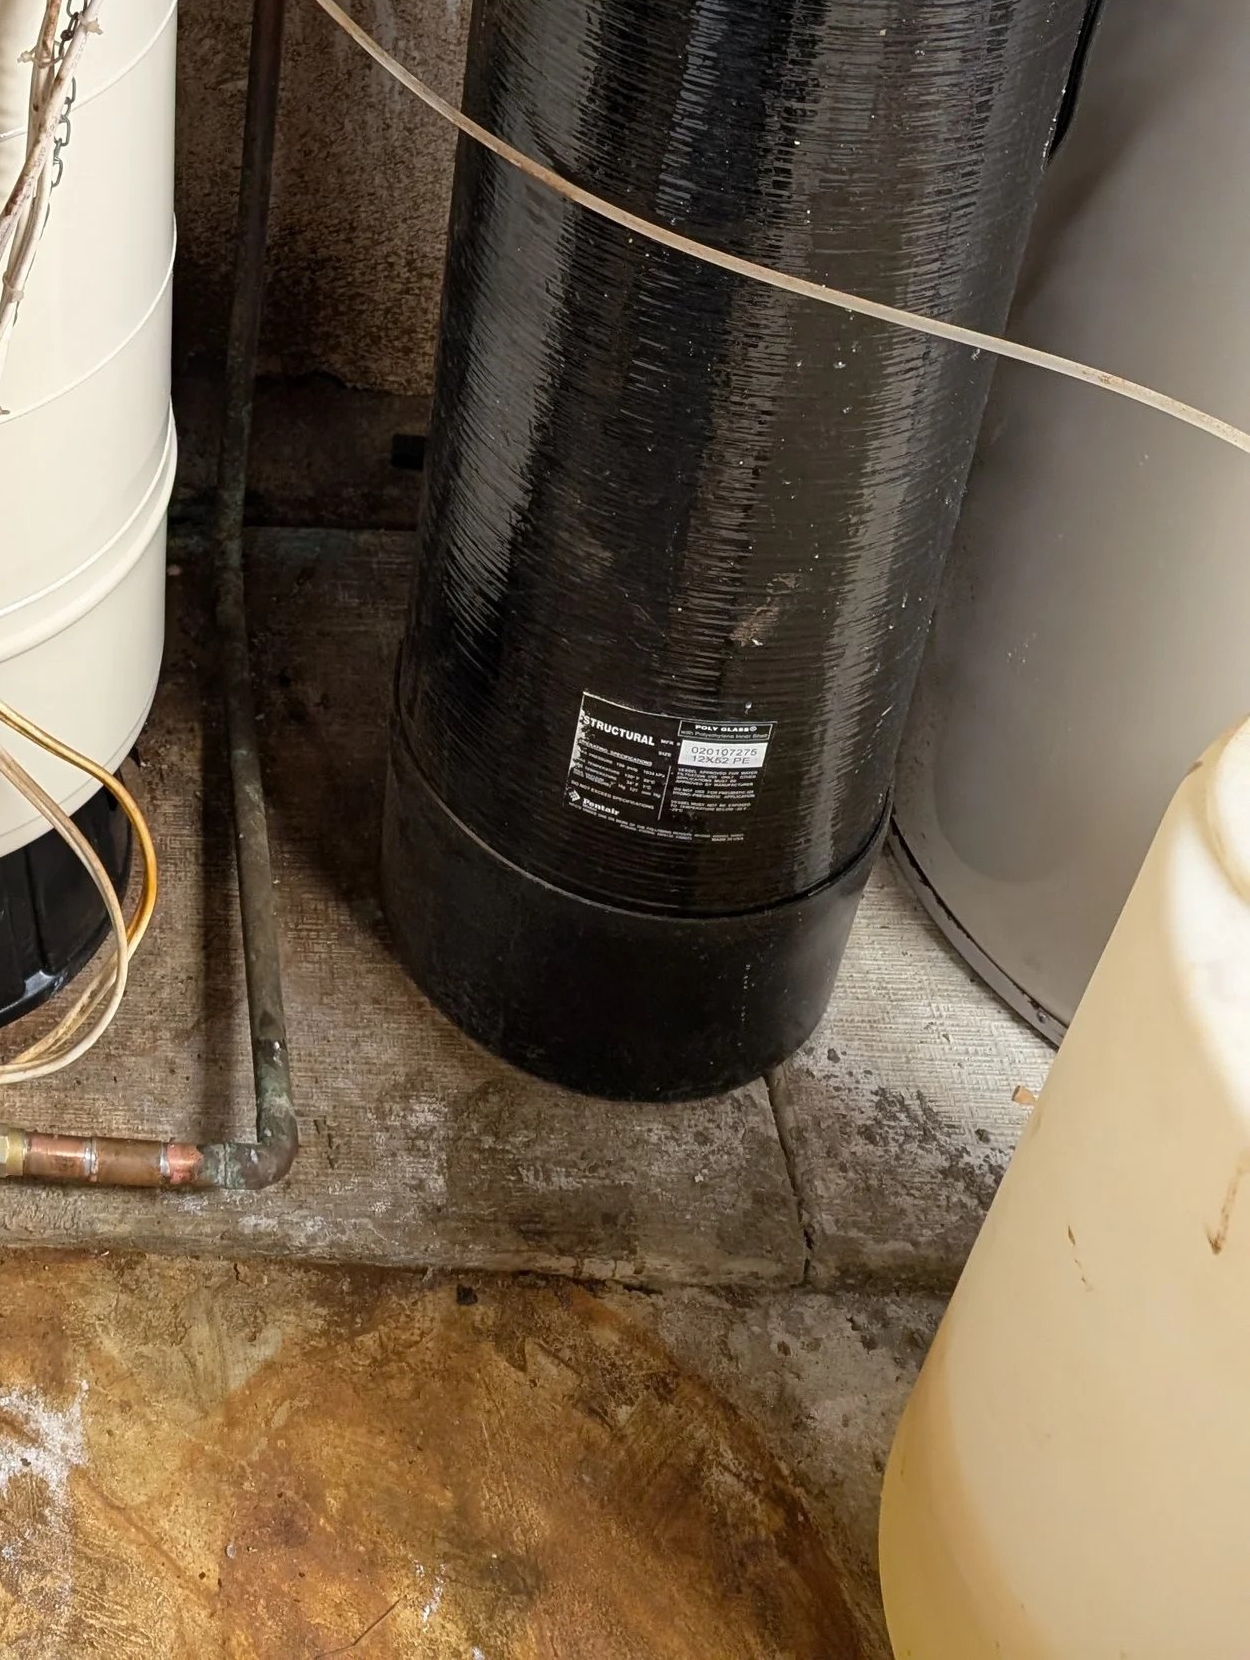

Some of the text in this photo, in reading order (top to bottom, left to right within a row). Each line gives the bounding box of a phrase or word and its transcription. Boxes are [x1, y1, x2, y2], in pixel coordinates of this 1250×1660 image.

[583, 715, 655, 746] STRUCTURAL
[691, 746, 758, 757] 020107275
[692, 756, 751, 765] 12X52 PE
[583, 798, 619, 816] Pentair
